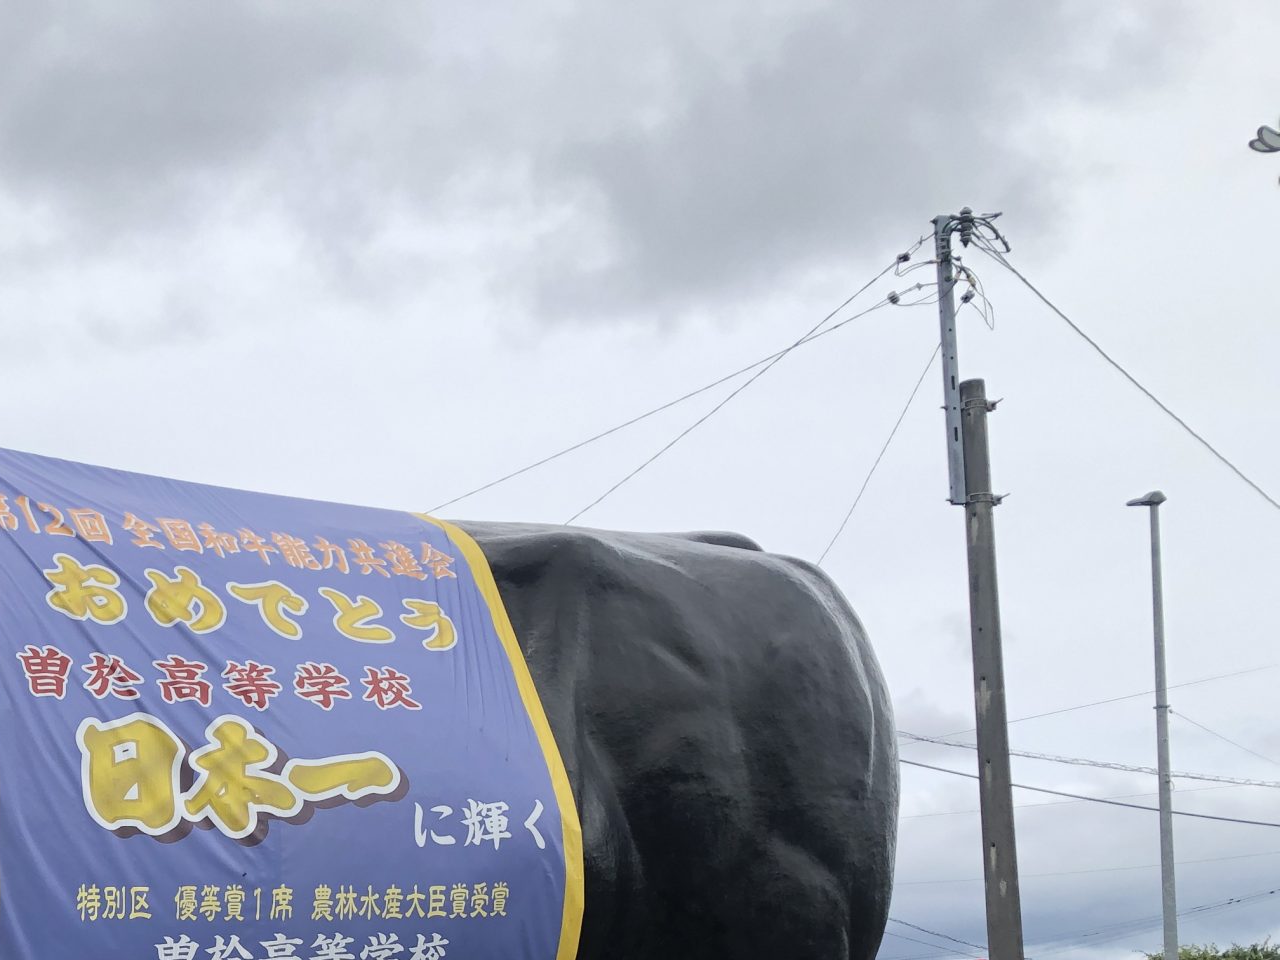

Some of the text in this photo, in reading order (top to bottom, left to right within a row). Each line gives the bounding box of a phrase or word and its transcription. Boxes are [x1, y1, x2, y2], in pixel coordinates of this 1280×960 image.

[122, 511, 459, 580] 全国和牛能力共進会
[44, 552, 459, 652] おめでとう
[17, 644, 423, 711] 曽於高等学校
[76, 711, 403, 840] 日本一
[413, 798, 547, 851] に輝く
[76, 881, 510, 922] 特別区 優等賞1席 農林水産大臣賞受賞
